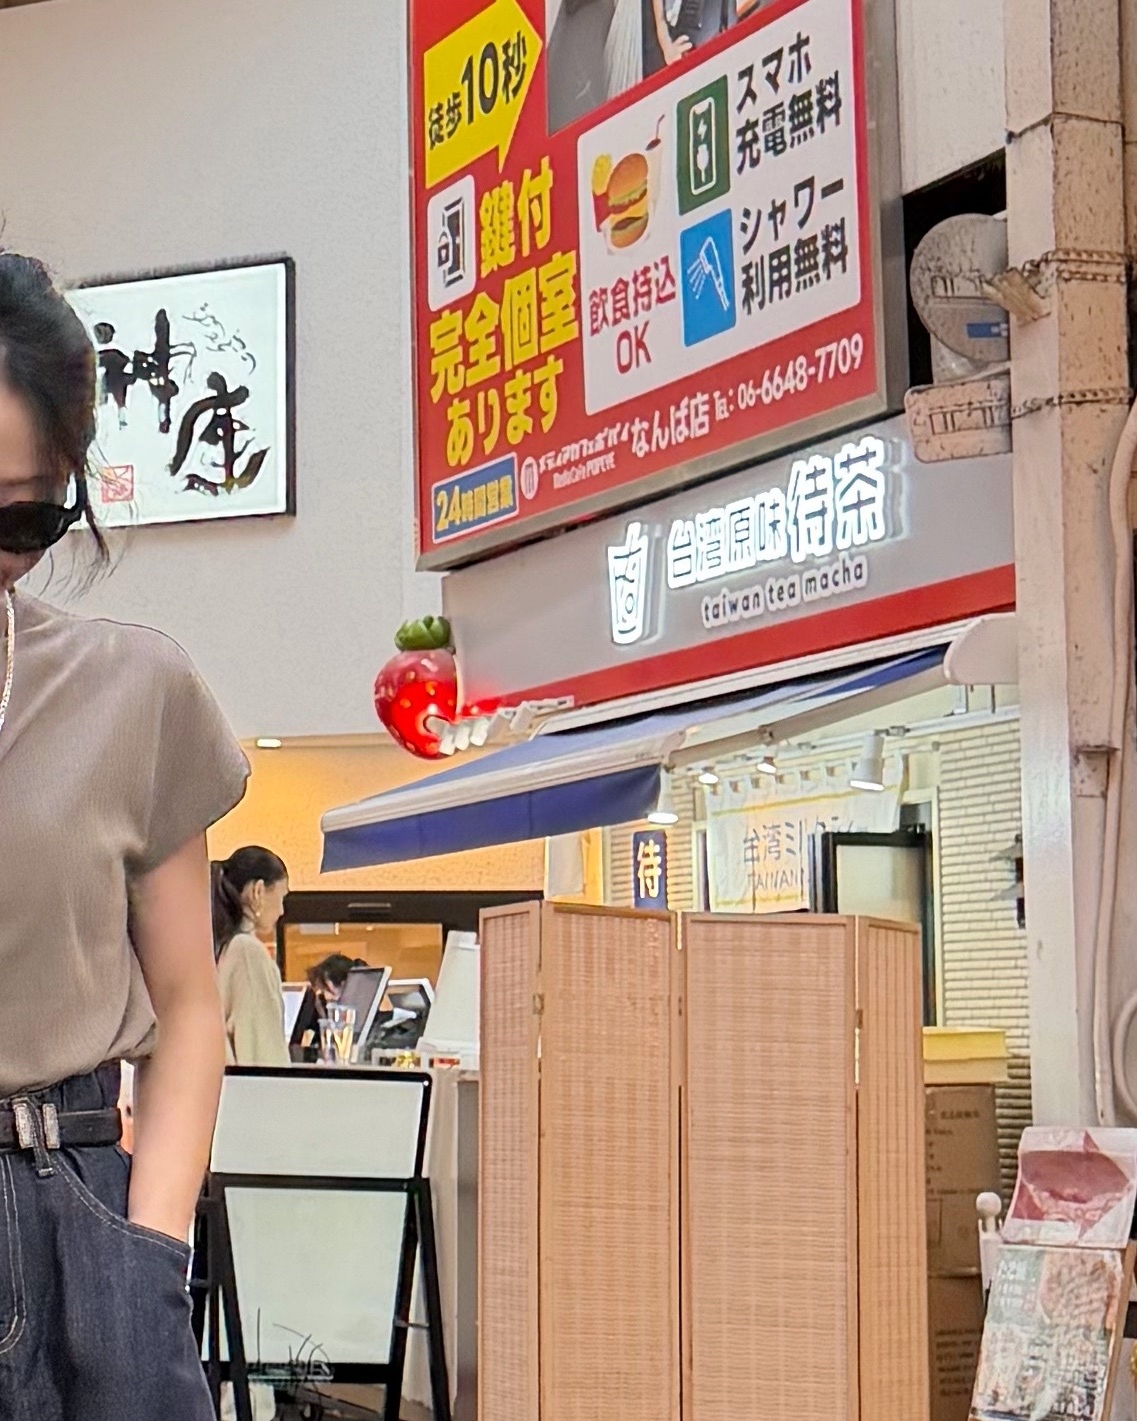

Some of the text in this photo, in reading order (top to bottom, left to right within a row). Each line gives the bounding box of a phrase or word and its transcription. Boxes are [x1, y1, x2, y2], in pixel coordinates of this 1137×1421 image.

[428, 30, 527, 150] 徒歩10秒
[736, 31, 812, 114] スマホ
[736, 70, 843, 175] 充電無料
[479, 155, 553, 278] 鍵付
[739, 175, 844, 254] シャワー
[589, 255, 676, 336] 飲食持込
[741, 217, 849, 315] 利用無料
[429, 250, 579, 404] 完全個室
[616, 322, 652, 374] OK
[446, 354, 564, 466] あります
[631, 391, 710, 459] なんば店
[738, 332, 864, 411] 06-6648-7709
[703, 559, 864, 623] taiwan tea macha
